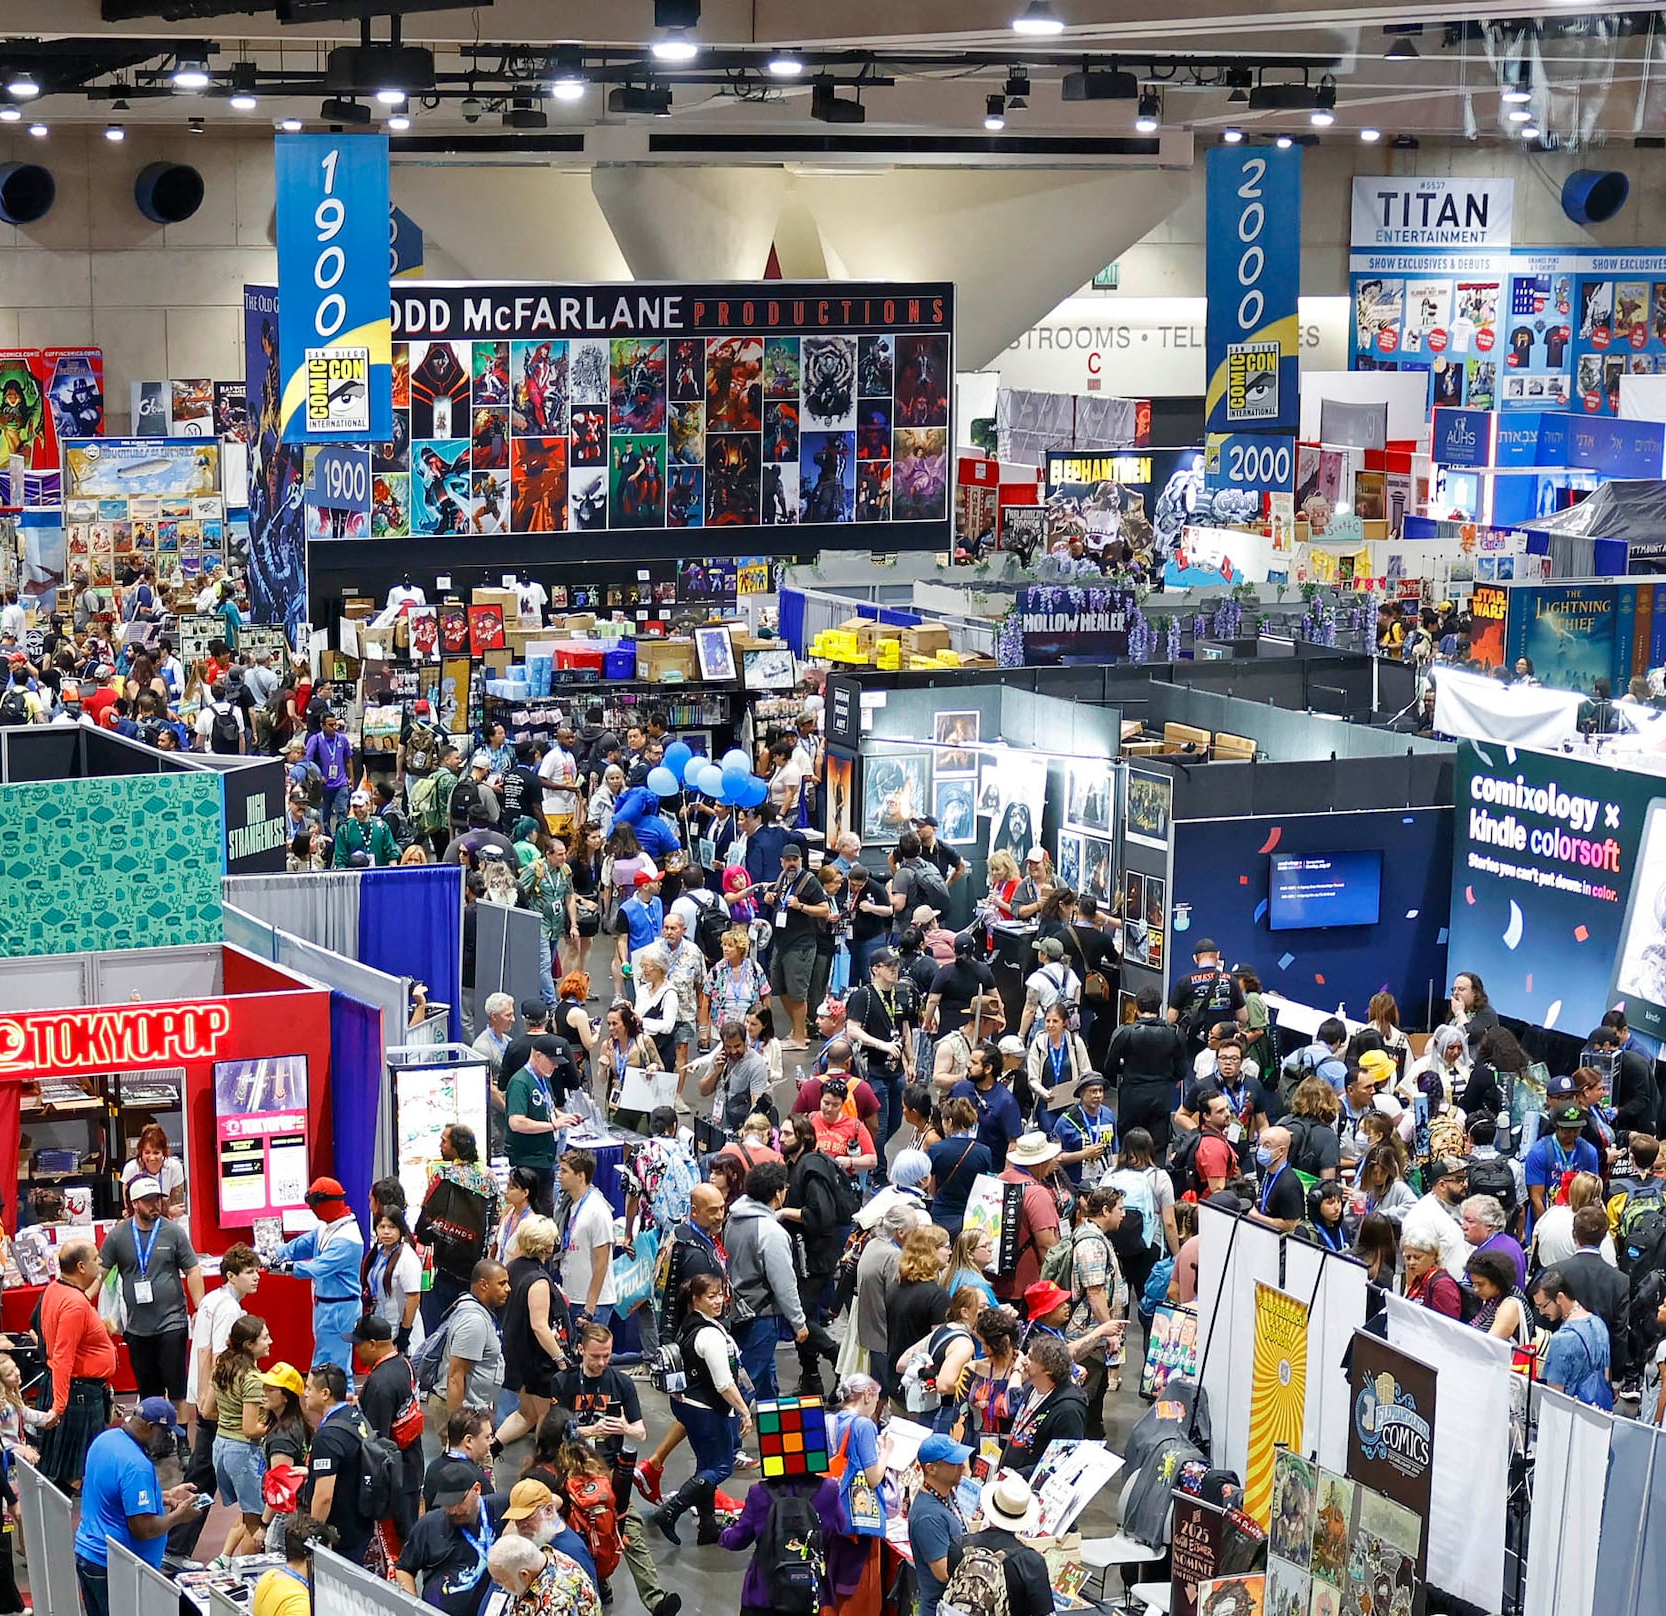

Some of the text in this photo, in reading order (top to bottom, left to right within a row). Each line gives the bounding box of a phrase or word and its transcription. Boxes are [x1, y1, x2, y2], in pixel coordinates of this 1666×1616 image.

[1420, 181, 1445, 190] #5537
[1378, 192, 1488, 227] TITAN
[314, 149, 347, 336] 1900
[1237, 158, 1265, 330] 2000
[1376, 229, 1487, 244] ENTERTAINMENT
[1369, 257, 1490, 271] SHOW EXCLUSIVES & DEBUTS
[1592, 257, 1614, 271] SHOW
[244, 291, 273, 313] THE OLD
[464, 296, 683, 332] McFARLANE
[694, 299, 944, 326] PRODUCTIONS
[328, 358, 364, 380] CON
[1088, 352, 1101, 374] C
[1247, 352, 1276, 372] CON
[310, 358, 328, 417] COMIC
[1229, 353, 1246, 409] COMIC
[1229, 407, 1277, 417] INTERNATIONAL
[309, 419, 367, 429] INTERNATIONAL
[1049, 458, 1153, 485] ELEPHANTMEN
[1229, 446, 1289, 484] 2000
[322, 458, 364, 501] 1900
[1475, 588, 1504, 603] STAR
[1566, 589, 1581, 599] THE
[1473, 601, 1505, 619] WARS
[1536, 598, 1610, 618] LIGHTNING
[1024, 612, 1126, 633] HOLLOW HEALER
[1554, 614, 1596, 636] THIEF
[246, 795, 267, 825] HIGH
[1471, 776, 1597, 829] comixology
[229, 814, 286, 858] STRANGENESS
[1469, 809, 1620, 873] kindle colorsoft
[1468, 854, 1498, 871] Stories
[1501, 862, 1516, 878] you
[1517, 862, 1536, 881] can't
[1538, 869, 1553, 886] put
[1582, 880, 1590, 893] in
[1592, 882, 1618, 902] color.
[26, 1004, 229, 1067] TOKYOPOP
[241, 1115, 298, 1134] TOKYOPOP
[1383, 1424, 1429, 1465] COMICS
[1181, 1520, 1209, 1537] 2025
